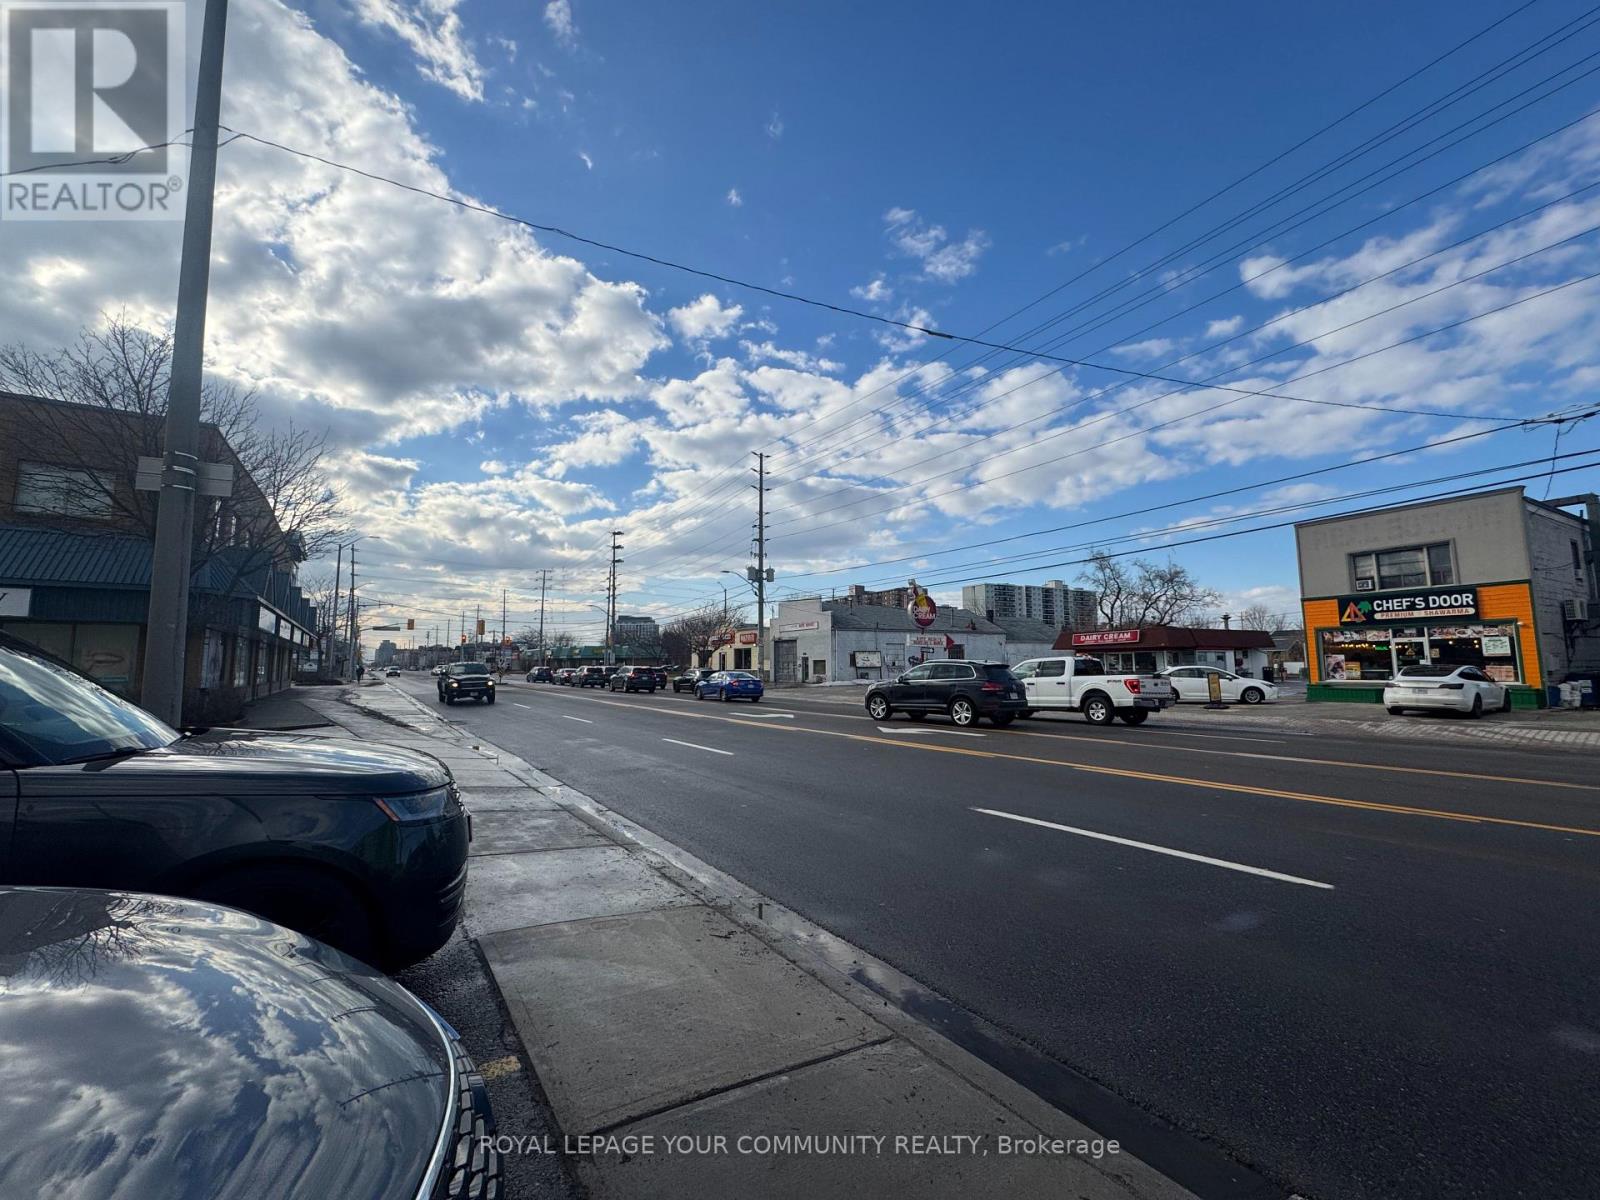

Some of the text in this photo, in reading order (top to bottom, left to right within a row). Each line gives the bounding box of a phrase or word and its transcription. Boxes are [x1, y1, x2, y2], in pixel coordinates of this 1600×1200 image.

[1373, 593, 1474, 611] CHEF'S DOOR
[1423, 608, 1470, 616] SHAWARMA
[1080, 634, 1102, 642] DAIRY
[1103, 632, 1131, 640] CREAM
